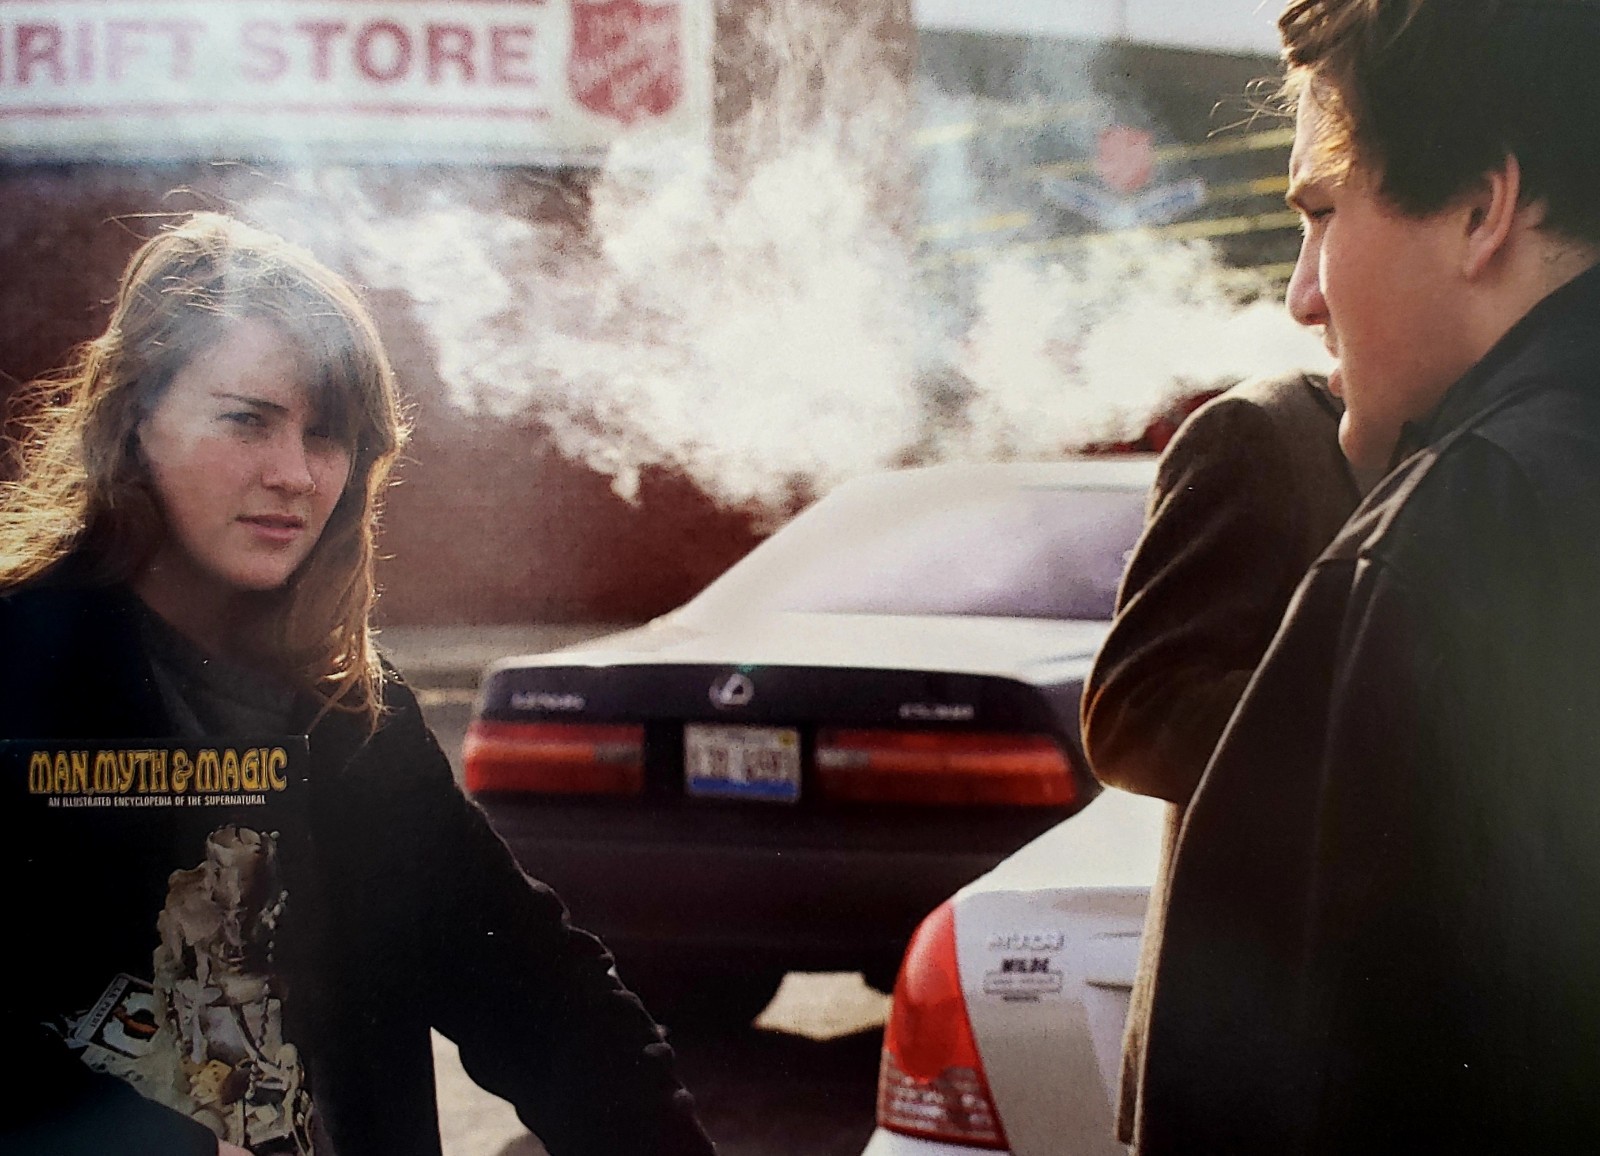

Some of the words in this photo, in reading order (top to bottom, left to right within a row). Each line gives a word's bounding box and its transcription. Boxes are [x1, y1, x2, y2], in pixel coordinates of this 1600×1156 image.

[0, 21, 205, 84] RIFT
[240, 20, 536, 86] STORE
[94, 749, 169, 793] MYTH
[171, 750, 193, 792] &
[195, 747, 287, 792] MAGIC
[48, 796, 60, 807] AN
[63, 796, 111, 807] ILLUSTRATED
[114, 796, 172, 807] ENCYCLOPEDIA
[175, 796, 185, 806] OF
[188, 795, 202, 806] THE
[204, 794, 266, 806] SUPERNATURAL
